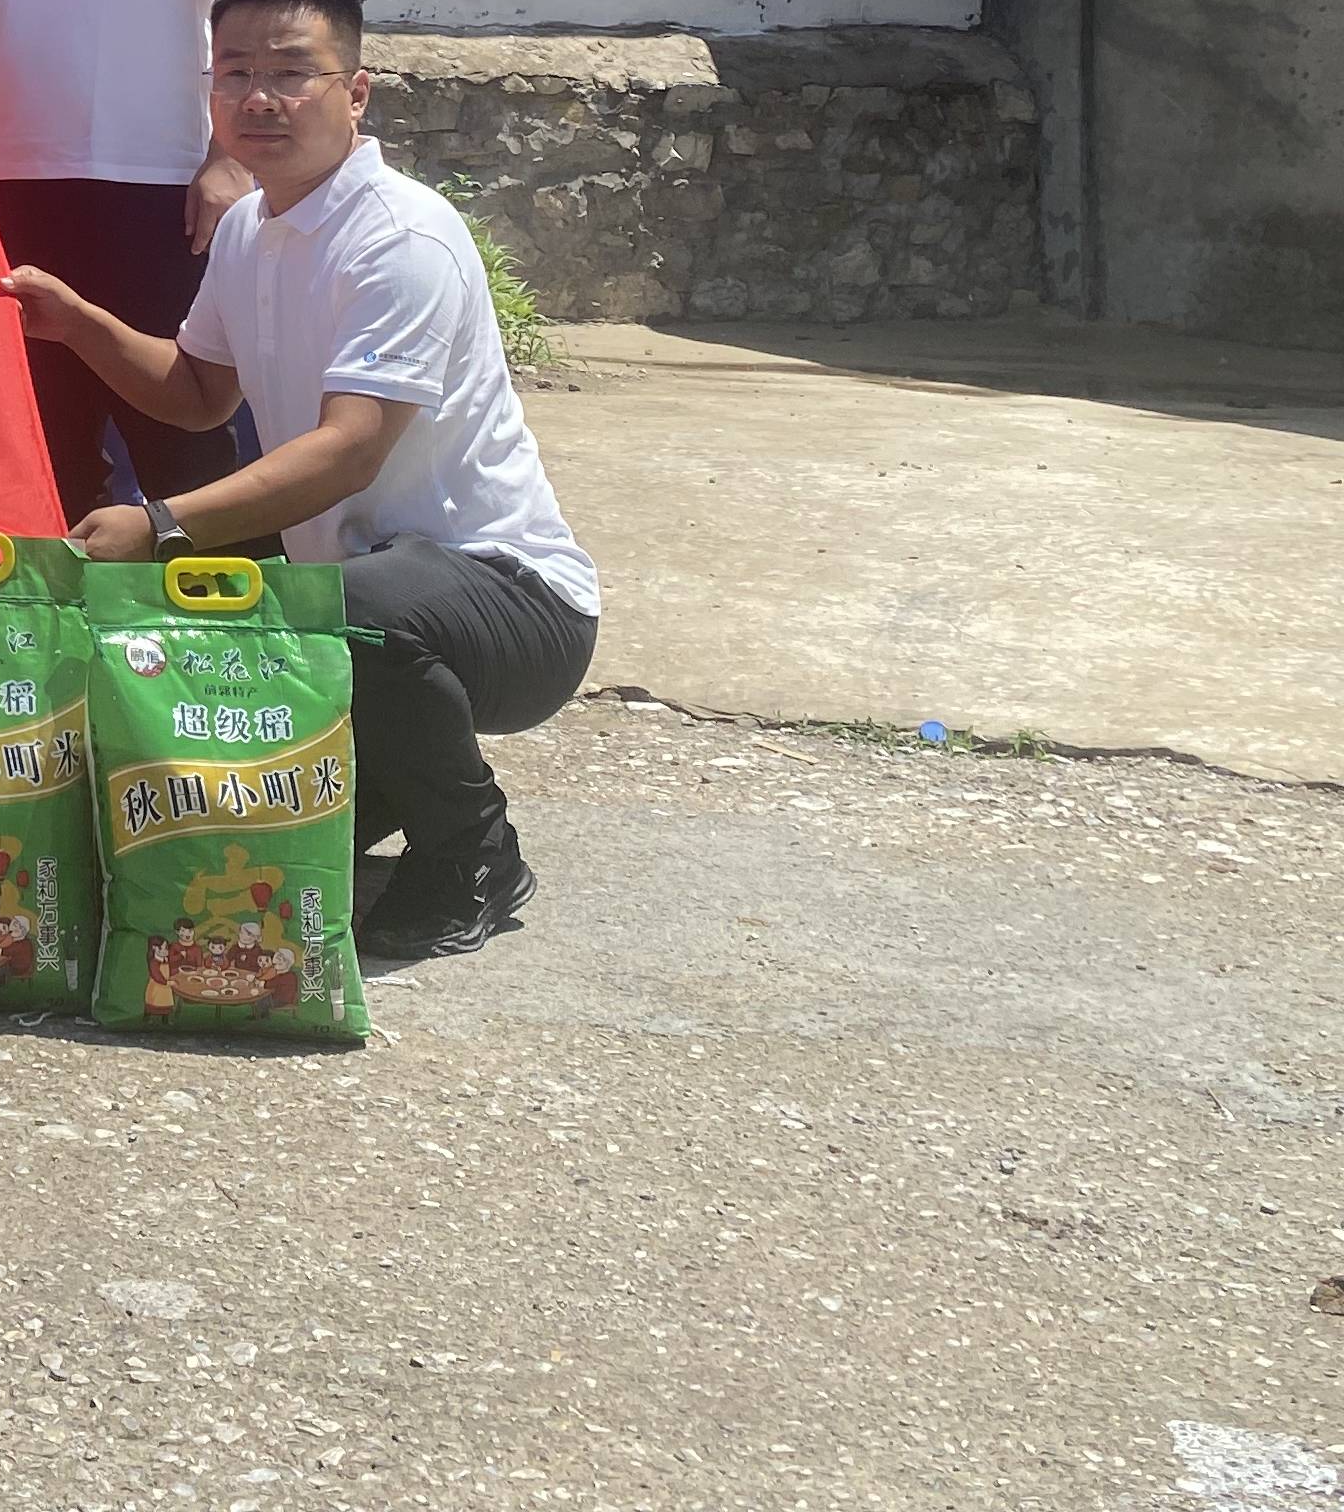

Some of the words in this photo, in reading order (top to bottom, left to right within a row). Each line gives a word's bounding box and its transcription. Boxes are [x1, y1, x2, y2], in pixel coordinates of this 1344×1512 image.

[180, 646, 291, 683] 松花江
[172, 700, 294, 744] 超级稻
[121, 756, 346, 837] 秋田小町米
[35, 855, 61, 973] 家和万事兴
[299, 886, 325, 1002] 家和万事兴
